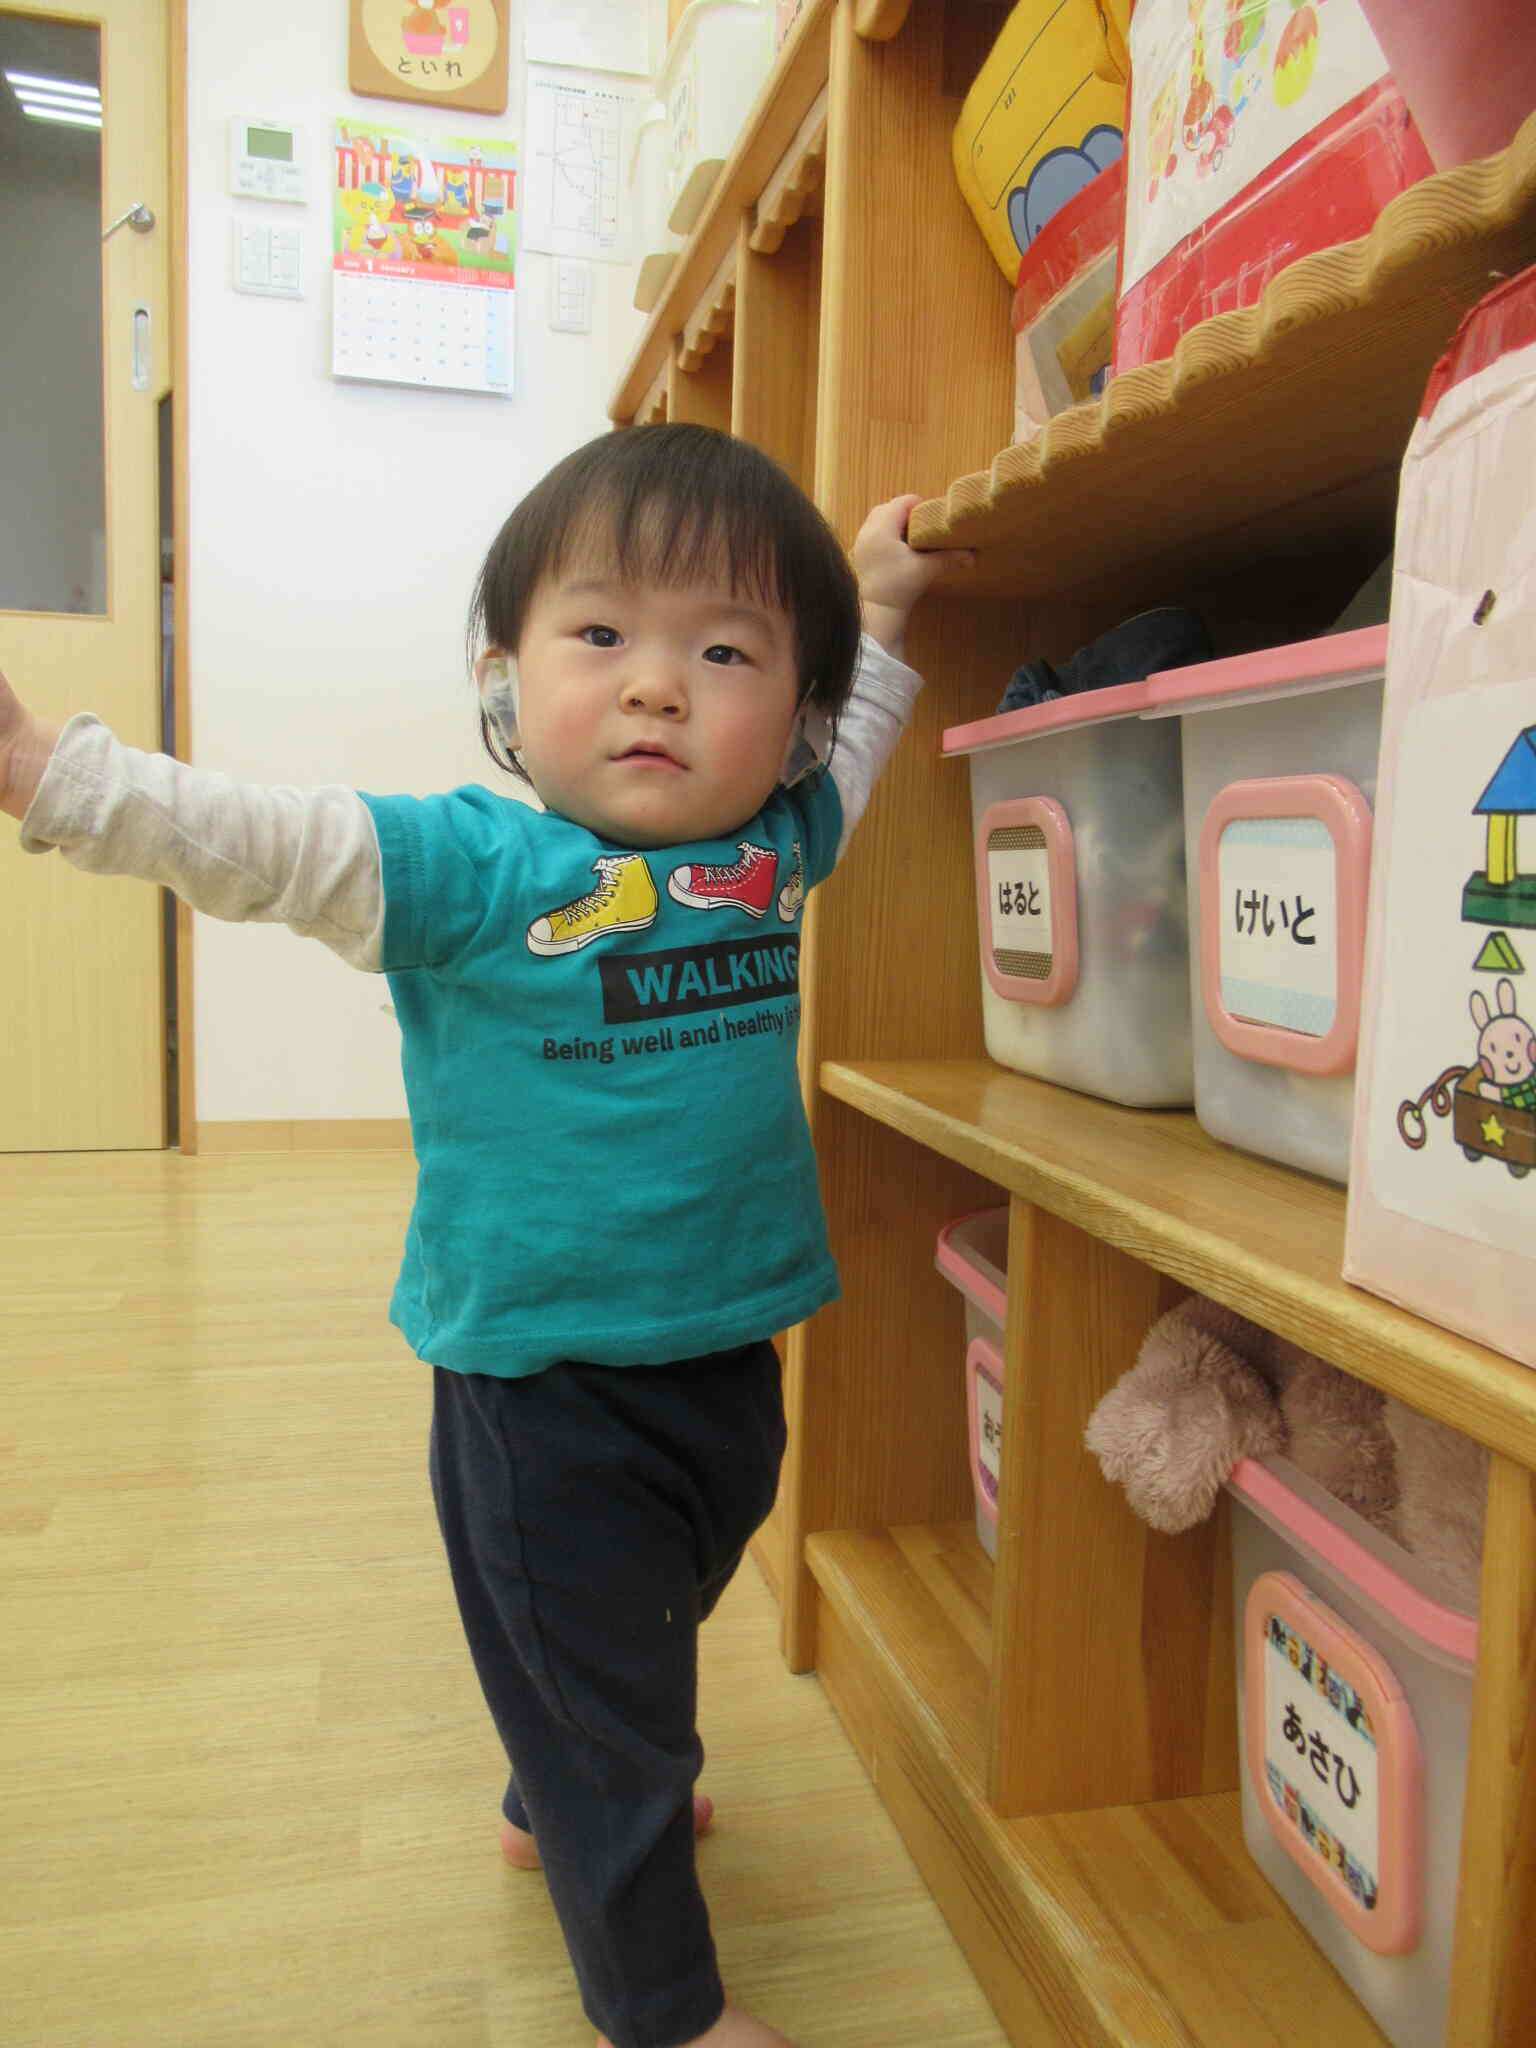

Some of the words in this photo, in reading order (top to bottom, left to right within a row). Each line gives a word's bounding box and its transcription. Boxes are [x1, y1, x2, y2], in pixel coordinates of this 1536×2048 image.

[398, 55, 463, 78] といれ
[999, 880, 1041, 916] はると
[1235, 889, 1316, 945] けいと
[627, 943, 798, 1007] WALKING
[543, 1037, 615, 1064] Being
[623, 1027, 674, 1057] well
[680, 1019, 721, 1049] and
[722, 1009, 784, 1041] healthy
[1281, 1703, 1361, 1810] あさひ
